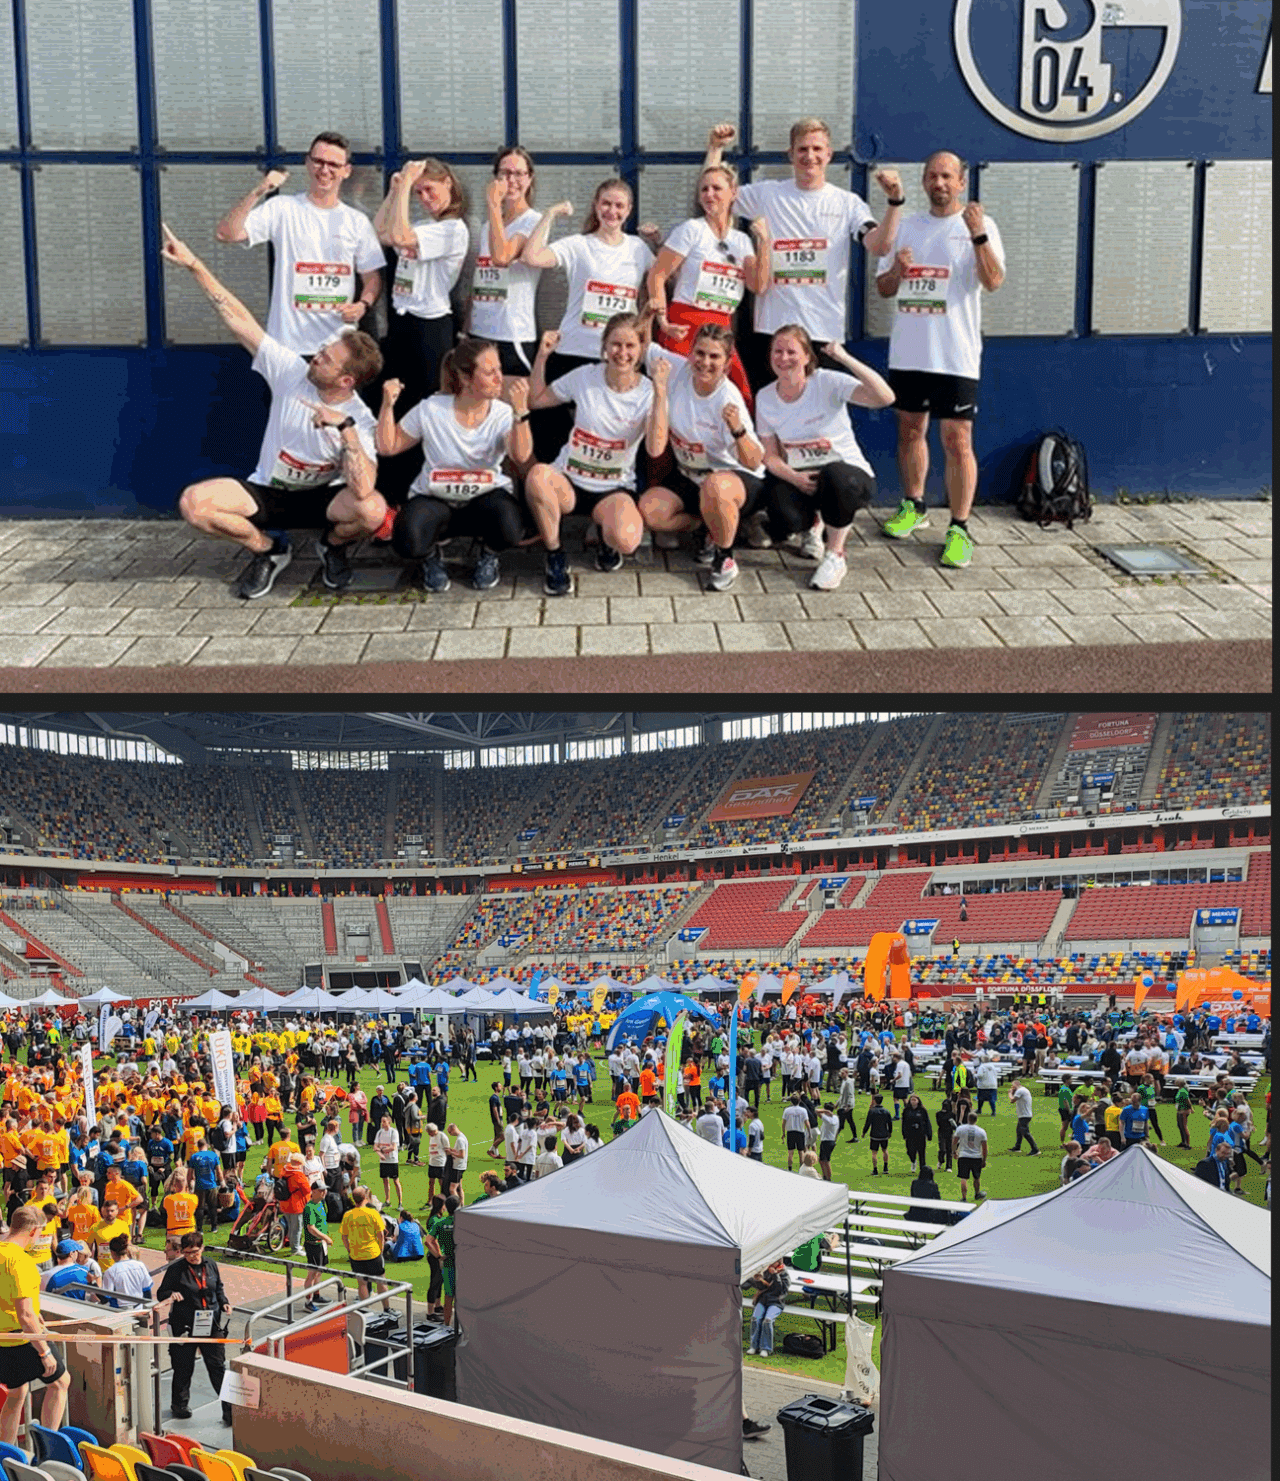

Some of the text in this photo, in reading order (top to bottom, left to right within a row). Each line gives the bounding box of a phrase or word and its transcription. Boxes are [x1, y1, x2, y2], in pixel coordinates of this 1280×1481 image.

[785, 250, 815, 262] 1183
[309, 274, 340, 288] 1179
[909, 279, 936, 291] 1178
[445, 484, 479, 496] 1182
[728, 783, 799, 801] DAK
[653, 852, 679, 862] Henkel
[1211, 910, 1237, 918] MERKUR
